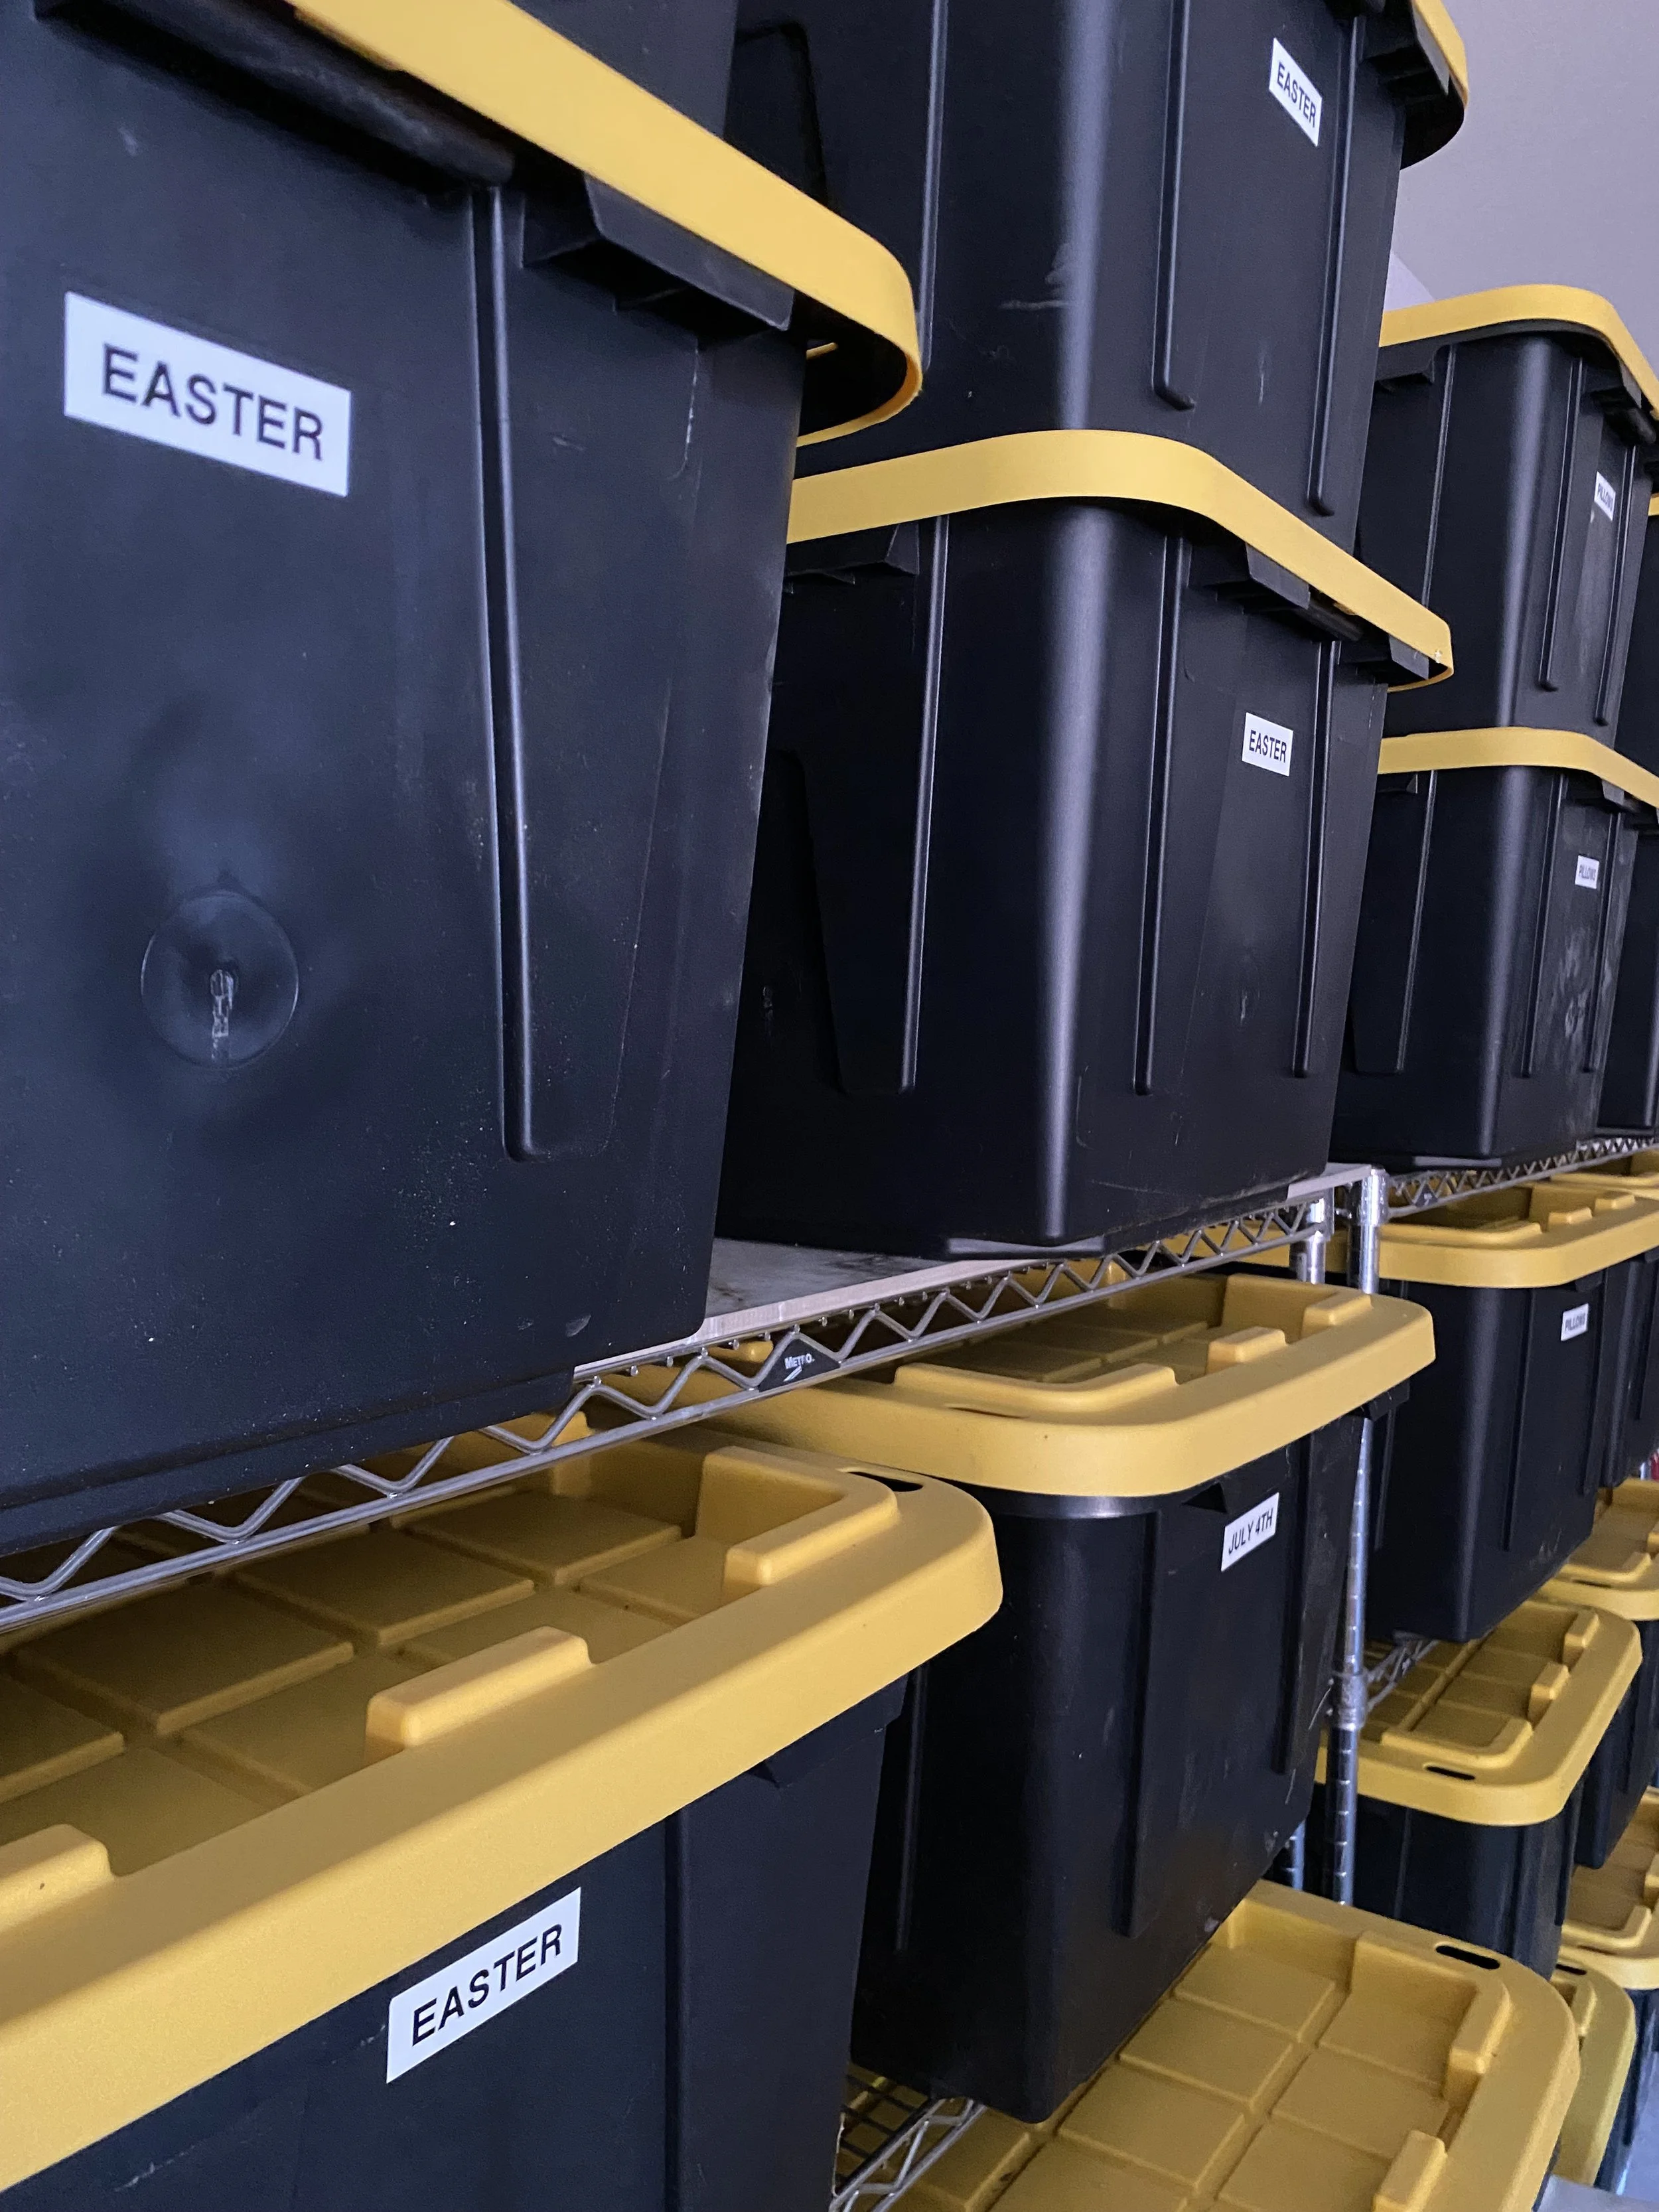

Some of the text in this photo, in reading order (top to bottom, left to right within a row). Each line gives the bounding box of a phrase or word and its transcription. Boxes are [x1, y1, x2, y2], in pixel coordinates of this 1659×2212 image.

[1277, 61, 1315, 127] EASTER
[102, 342, 323, 461] EASTER
[1249, 730, 1286, 763] EASTER
[1228, 1508, 1273, 1555] JULY 4TH
[412, 1923, 562, 2046] EASTER
